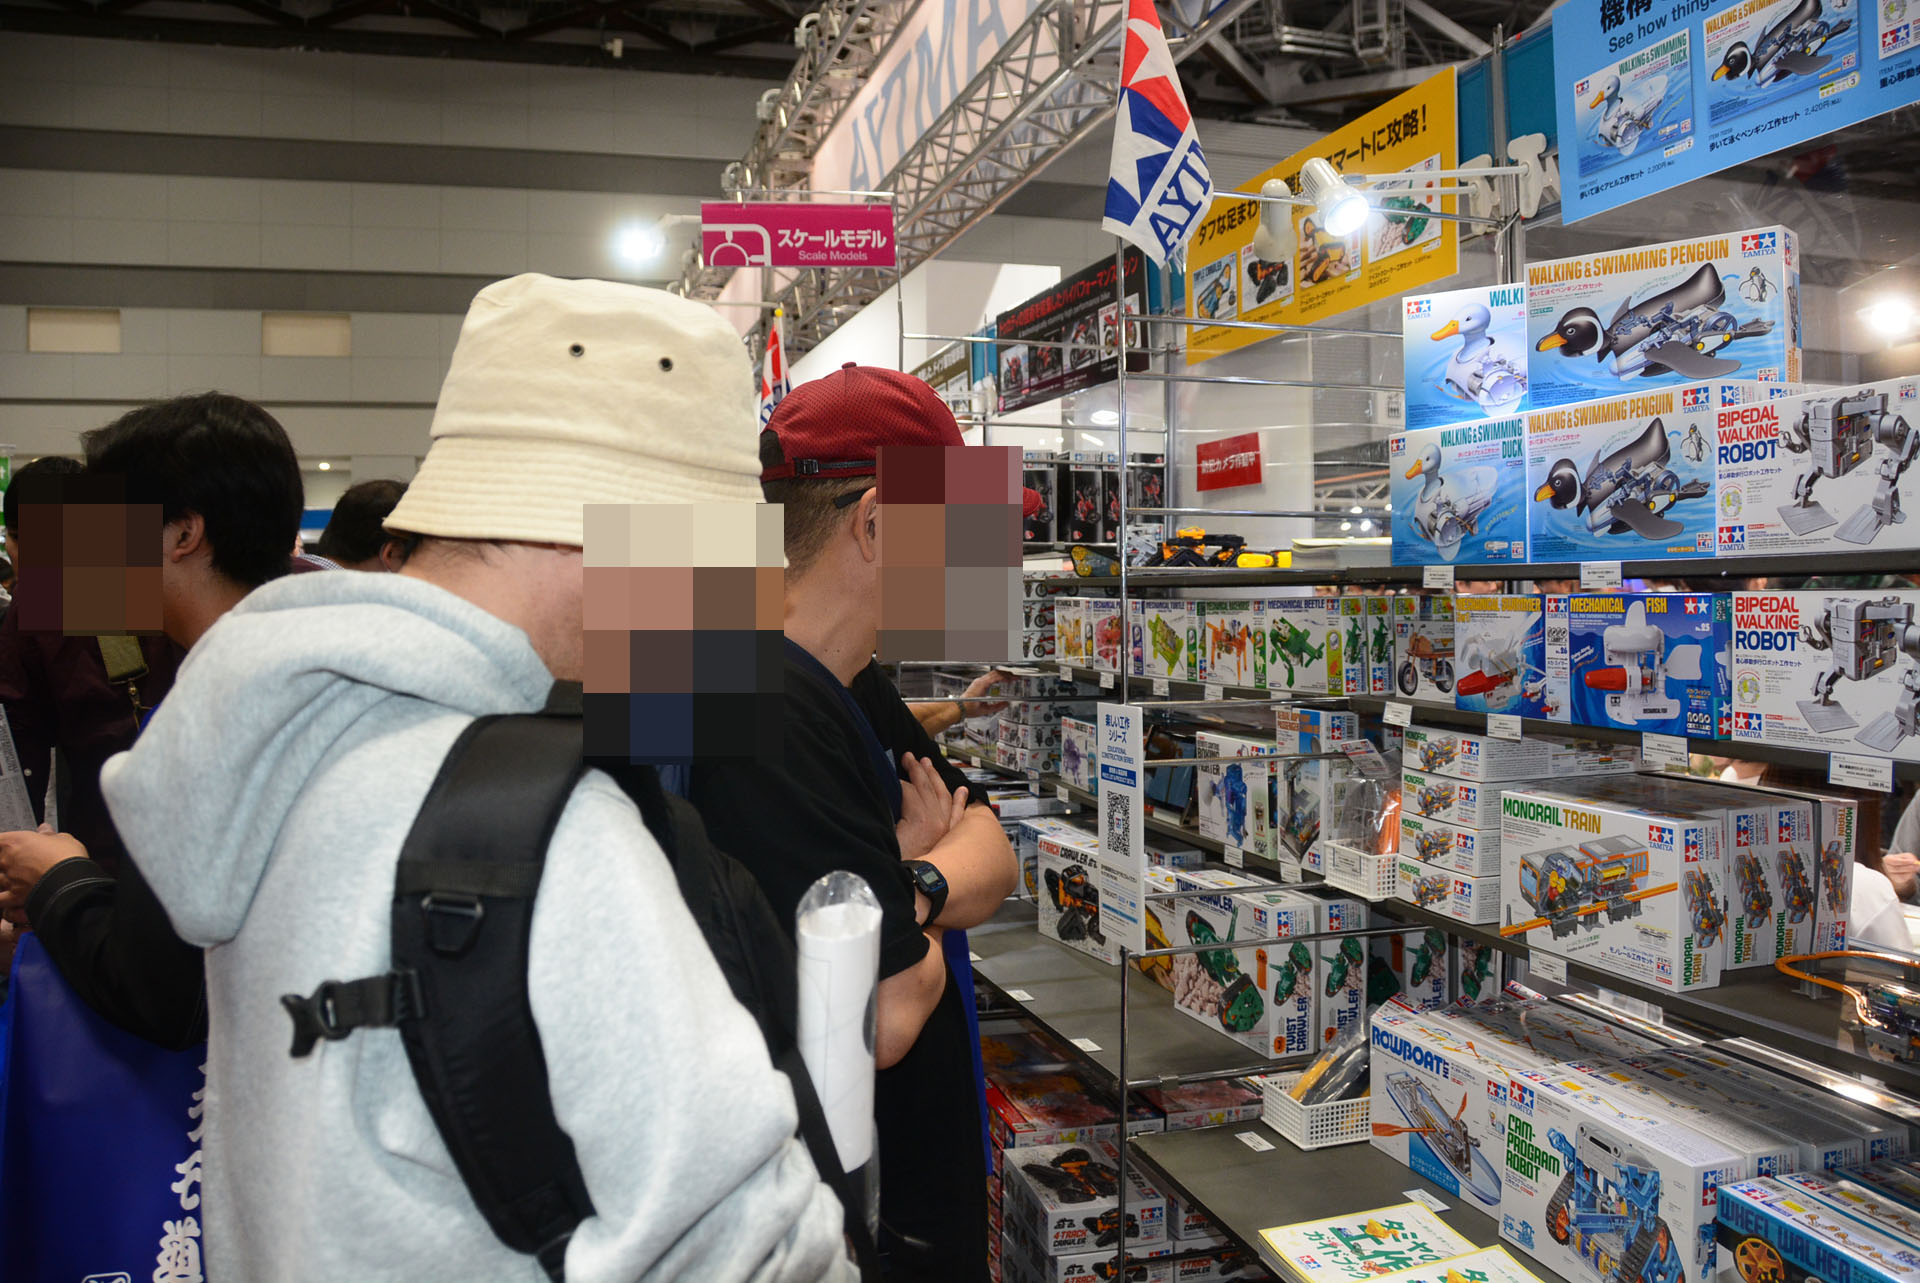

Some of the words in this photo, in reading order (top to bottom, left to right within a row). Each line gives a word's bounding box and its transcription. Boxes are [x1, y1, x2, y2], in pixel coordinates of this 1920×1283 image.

[1705, 9, 1738, 35] WALKING
[1609, 32, 1634, 53] See
[1638, 14, 1667, 40] how
[1619, 56, 1646, 76] WALKING
[1650, 33, 1688, 61] SWIMMING
[1670, 47, 1689, 67] DUCK
[1882, 39, 1910, 54] TAMIYA
[777, 228, 887, 249] スケールモデル
[798, 250, 827, 261] Scale
[829, 250, 868, 261] Models
[1528, 261, 1584, 287] WALKING
[1584, 262, 1592, 277] &
[1593, 249, 1667, 277] SWIMMING
[1670, 239, 1729, 267] PENGUIN
[1743, 249, 1777, 258] TAMIYA
[1489, 287, 1524, 308] WALKI
[1528, 410, 1566, 434] WALKING
[1567, 415, 1573, 428] &
[1573, 403, 1628, 428] SWIMMING
[1629, 392, 1673, 419] PENGUIN
[1683, 405, 1710, 414] TAMIYA
[1717, 404, 1780, 429] BIPEDAL
[1440, 426, 1472, 448] WALKING
[1472, 428, 1478, 443] &
[1478, 418, 1523, 443] SWIMMING
[1717, 421, 1780, 445] WALKING
[1502, 439, 1523, 459] DUCK
[1718, 438, 1780, 465] ROBOT
[1719, 539, 1745, 551] TAMIYA
[1267, 600, 1304, 609] MECHANICAL
[1304, 600, 1325, 609] BEETLE
[1455, 597, 1500, 611] MECHANICAL
[1501, 598, 1541, 612] SWIMMER
[1570, 597, 1626, 613] MECHANICAL
[1645, 597, 1668, 614] FISH
[1735, 596, 1800, 613] BIPEDAL
[1735, 614, 1800, 630] WALKING
[1735, 631, 1800, 651] ROBOT
[1105, 714, 1130, 730] 楽しい工作
[1109, 730, 1127, 743] シリーズ
[1735, 730, 1762, 739] TAMIYA
[1503, 797, 1563, 827] MONORAIL
[1563, 808, 1602, 834] TRAIN
[1845, 807, 1853, 856] MONORAIL
[1060, 847, 1088, 866] CRAWLER
[1649, 841, 1674, 853] TAMIYA
[1734, 914, 1744, 964] MONORAIL
[1776, 909, 1786, 959] MONORAIL
[1784, 928, 1793, 956] TRAIN
[1609, 946, 1655, 965] モノレール工作セット
[1743, 933, 1752, 963] TRAIN
[1683, 933, 1693, 986] MONORAIL
[1692, 953, 1702, 984] TRAIN
[1297, 997, 1307, 1051] CRAWLER
[1286, 1017, 1297, 1054] TWIST
[1372, 1025, 1444, 1076] ROWBOAT
[1510, 1100, 1534, 1117] TAMIYA
[1508, 1113, 1536, 1142] CAM-
[1506, 1149, 1541, 1184] ROBOT
[1507, 1135, 1560, 1177] PROGRAM
[1053, 1238, 1087, 1247] CRAWLER
[1054, 1229, 1088, 1240] 4-TRACK
[1385, 1219, 1441, 1261] タミヤの
[1719, 1196, 1770, 1238] WHEEL
[1777, 1226, 1850, 1283] WALKER
[1180, 1258, 1212, 1269] 4-TRACK
[1303, 1231, 1371, 1280] ガイドブック
[1179, 1267, 1211, 1276] CRAWLER
